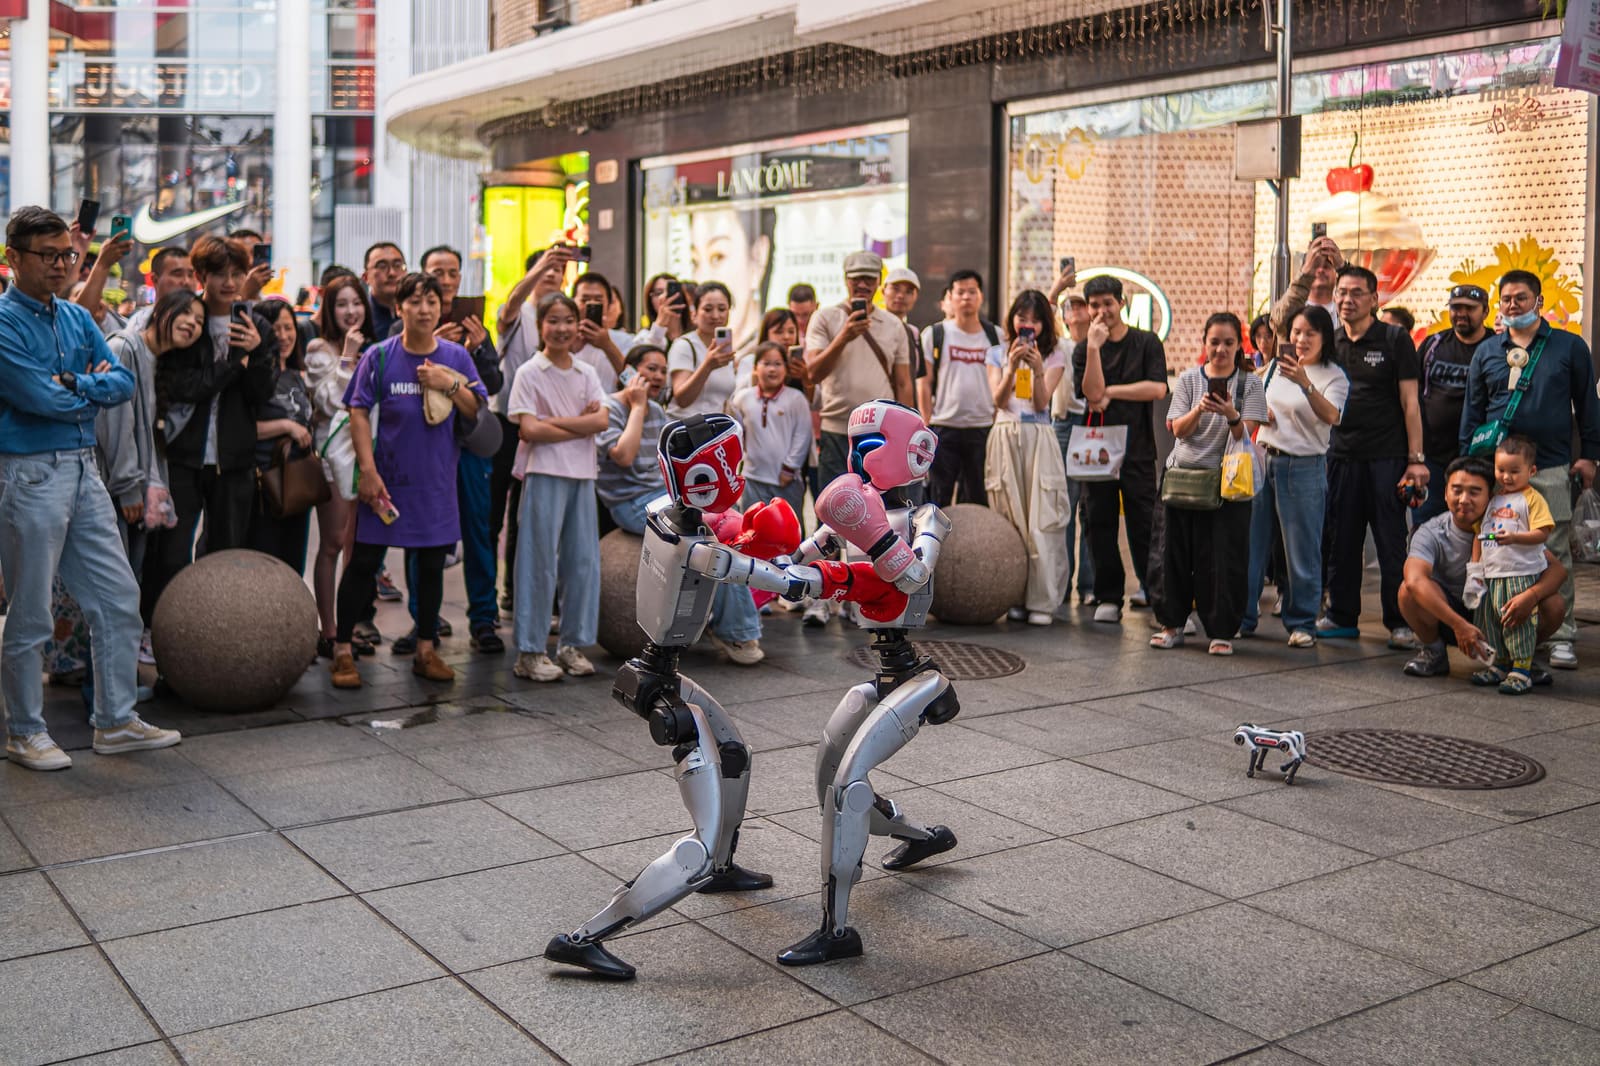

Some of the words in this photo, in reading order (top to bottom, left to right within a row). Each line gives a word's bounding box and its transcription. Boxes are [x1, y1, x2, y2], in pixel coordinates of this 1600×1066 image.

[87, 65, 188, 98] JUST
[203, 66, 262, 97] DO
[717, 158, 813, 198] LANCÔME
